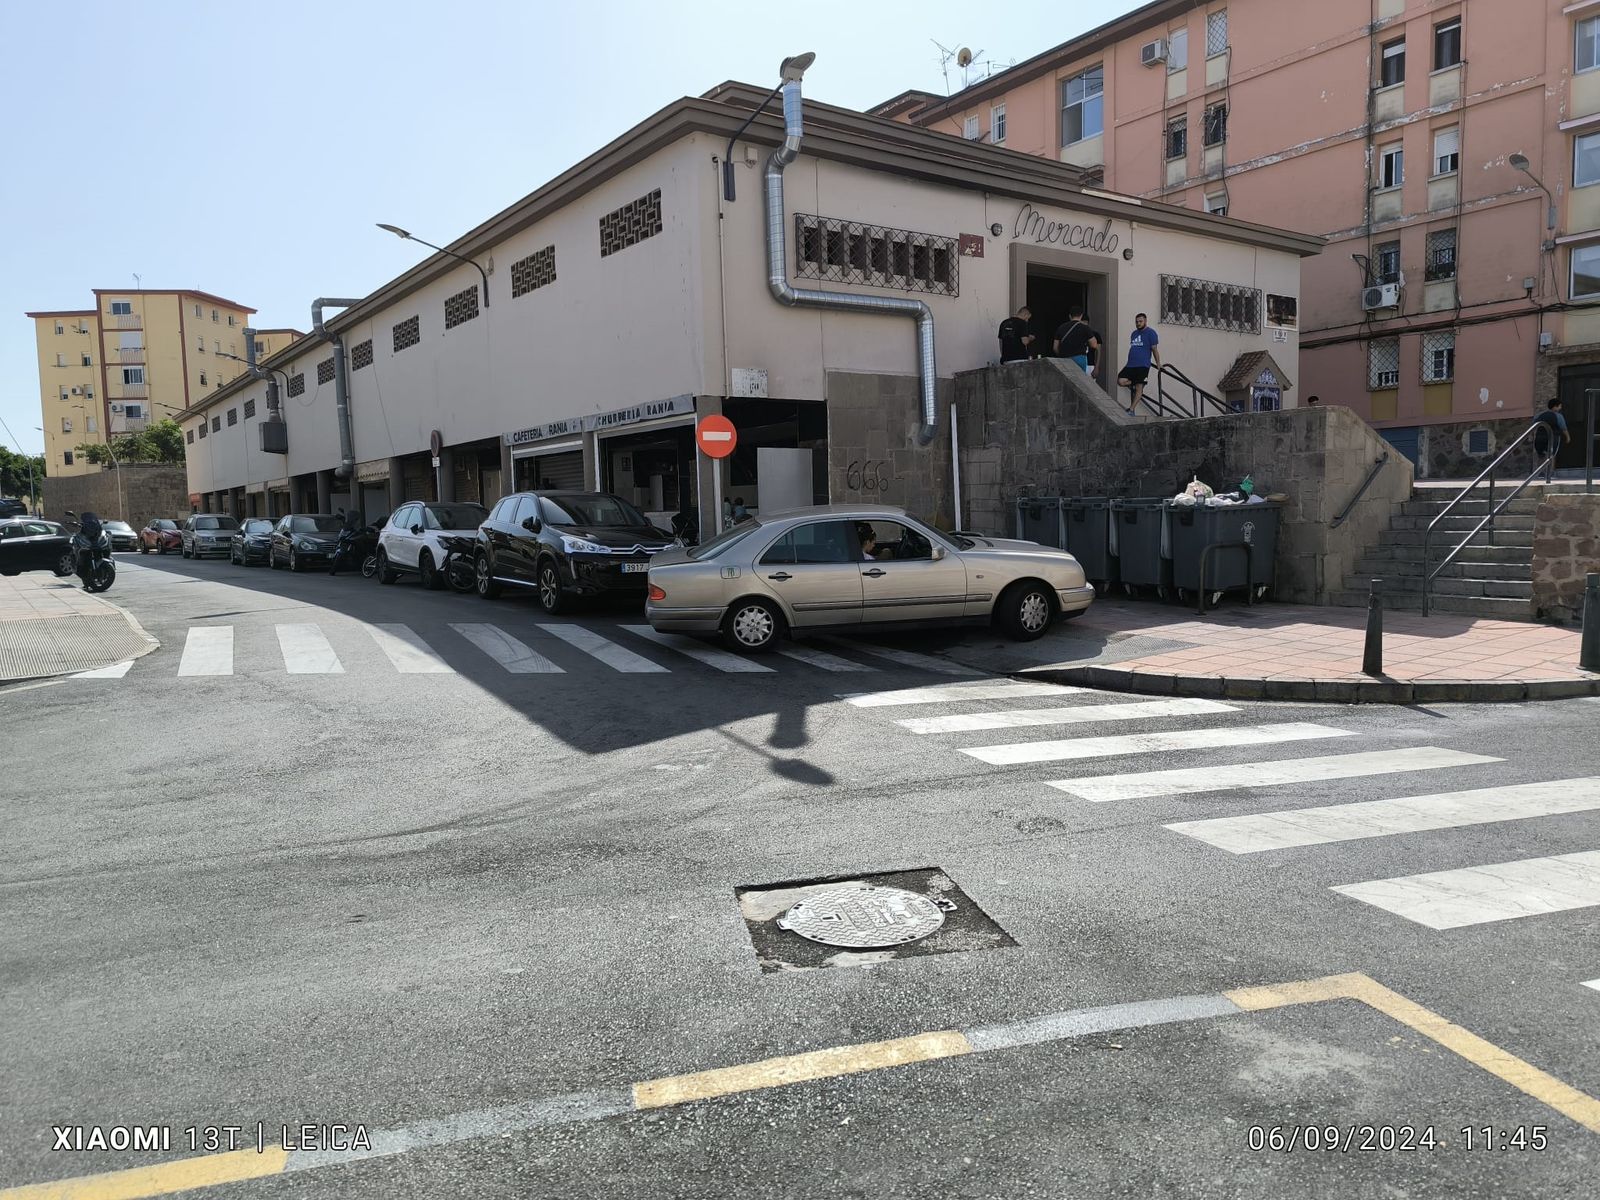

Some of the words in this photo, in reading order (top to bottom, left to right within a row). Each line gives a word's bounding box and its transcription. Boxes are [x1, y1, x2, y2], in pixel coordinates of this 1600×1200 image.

[1012, 203, 1119, 253] Mercado
[513, 428, 543, 443] CAFETERIA
[847, 460, 889, 491] 666
[626, 563, 644, 573] 3917
